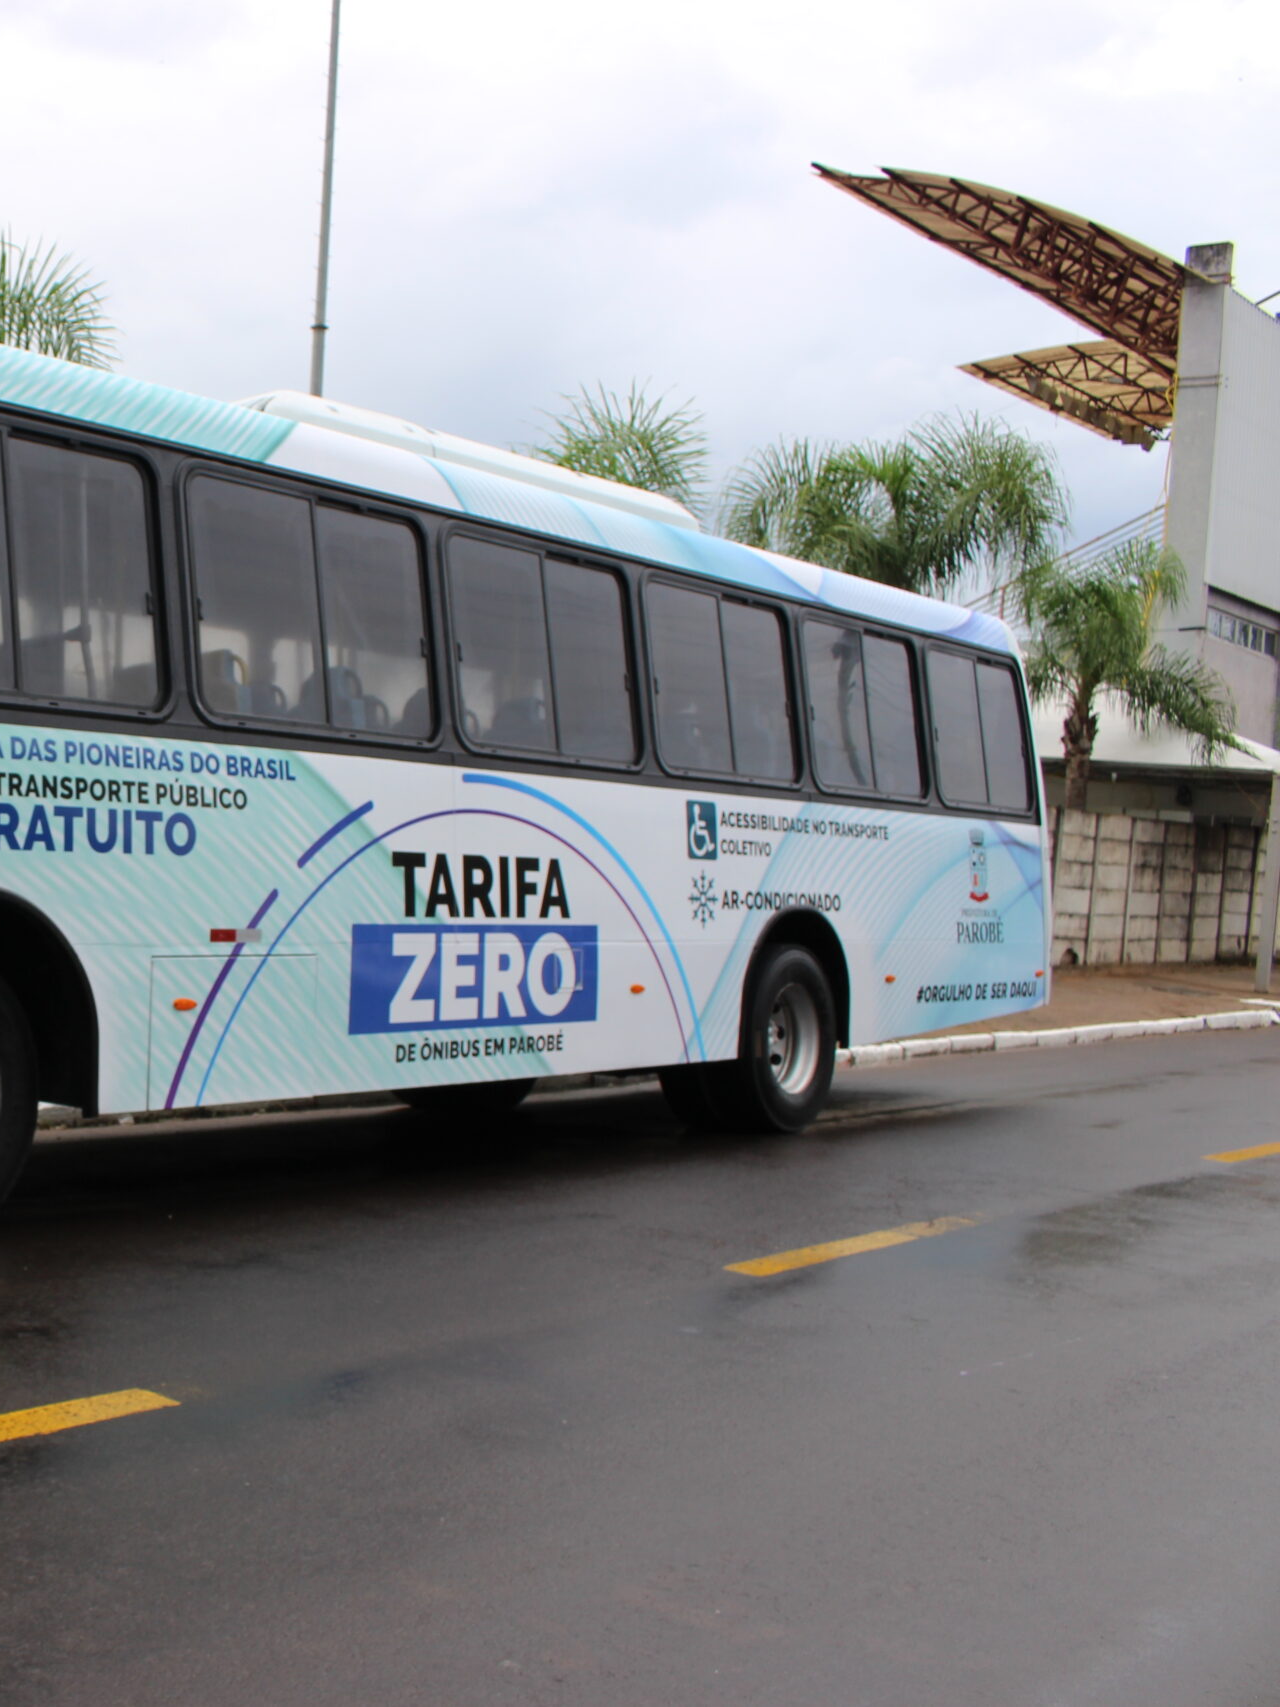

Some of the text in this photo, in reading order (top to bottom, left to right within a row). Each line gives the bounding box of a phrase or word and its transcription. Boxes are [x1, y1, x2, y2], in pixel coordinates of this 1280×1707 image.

[10, 736, 57, 762] DAS
[64, 741, 185, 774] PIONEIRAS
[190, 750, 221, 775] DO
[226, 755, 296, 781] BRASIL
[157, 778, 248, 810] PÚBLICO
[720, 811, 889, 841] ACESSIBILIDADE NO TRANSPORTE
[720, 839, 771, 857] COLETIVO
[391, 851, 571, 918] TARIFA
[721, 890, 841, 912] AR-CONDICIONADO
[956, 916, 1005, 944] PAROBÉ
[389, 932, 576, 1024] ZERO
[916, 980, 1037, 1003] #ORGULHO DE SER DAQUI
[395, 1029, 564, 1063] DE ÔNIBUS EM PAROBÉ
